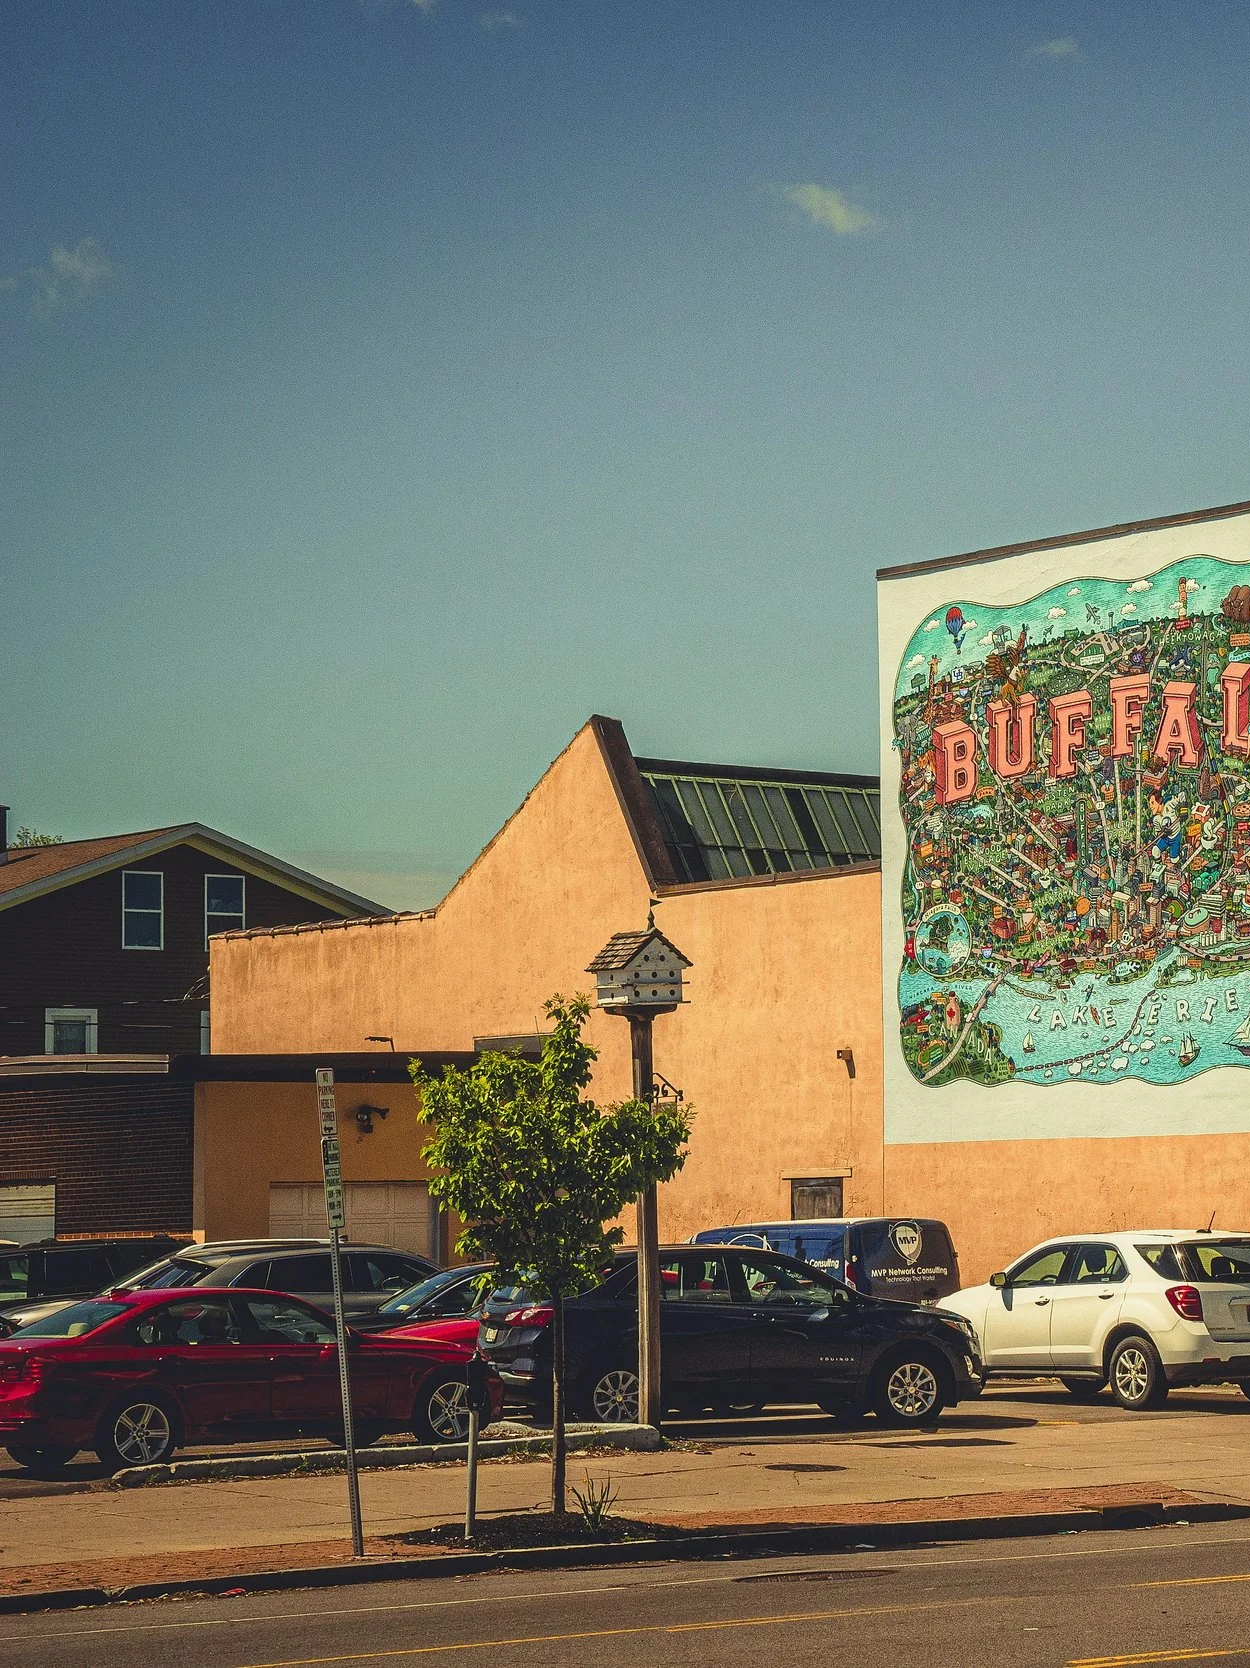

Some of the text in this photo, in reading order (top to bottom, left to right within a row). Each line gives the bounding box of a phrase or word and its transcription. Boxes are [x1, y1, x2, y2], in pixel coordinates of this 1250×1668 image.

[1153, 631, 1223, 646] CHEEKTOWAGA
[1038, 787, 1075, 804] MASTEN
[1045, 799, 1074, 812] PARK
[1078, 803, 1087, 866] BUFFALO
[925, 905, 944, 919] Niagara
[1027, 988, 1239, 1031] LAKE ERIE
[319, 1086, 335, 1095] PARKING
[322, 1111, 335, 1122] CORNER
[326, 1178, 341, 1187] PARKING
[898, 1236, 917, 1245] MVP
[809, 1258, 840, 1270] Consulting
[871, 1266, 948, 1278] MVP Network Consulting
[886, 1275, 912, 1284] Technology
[912, 1275, 921, 1283] That
